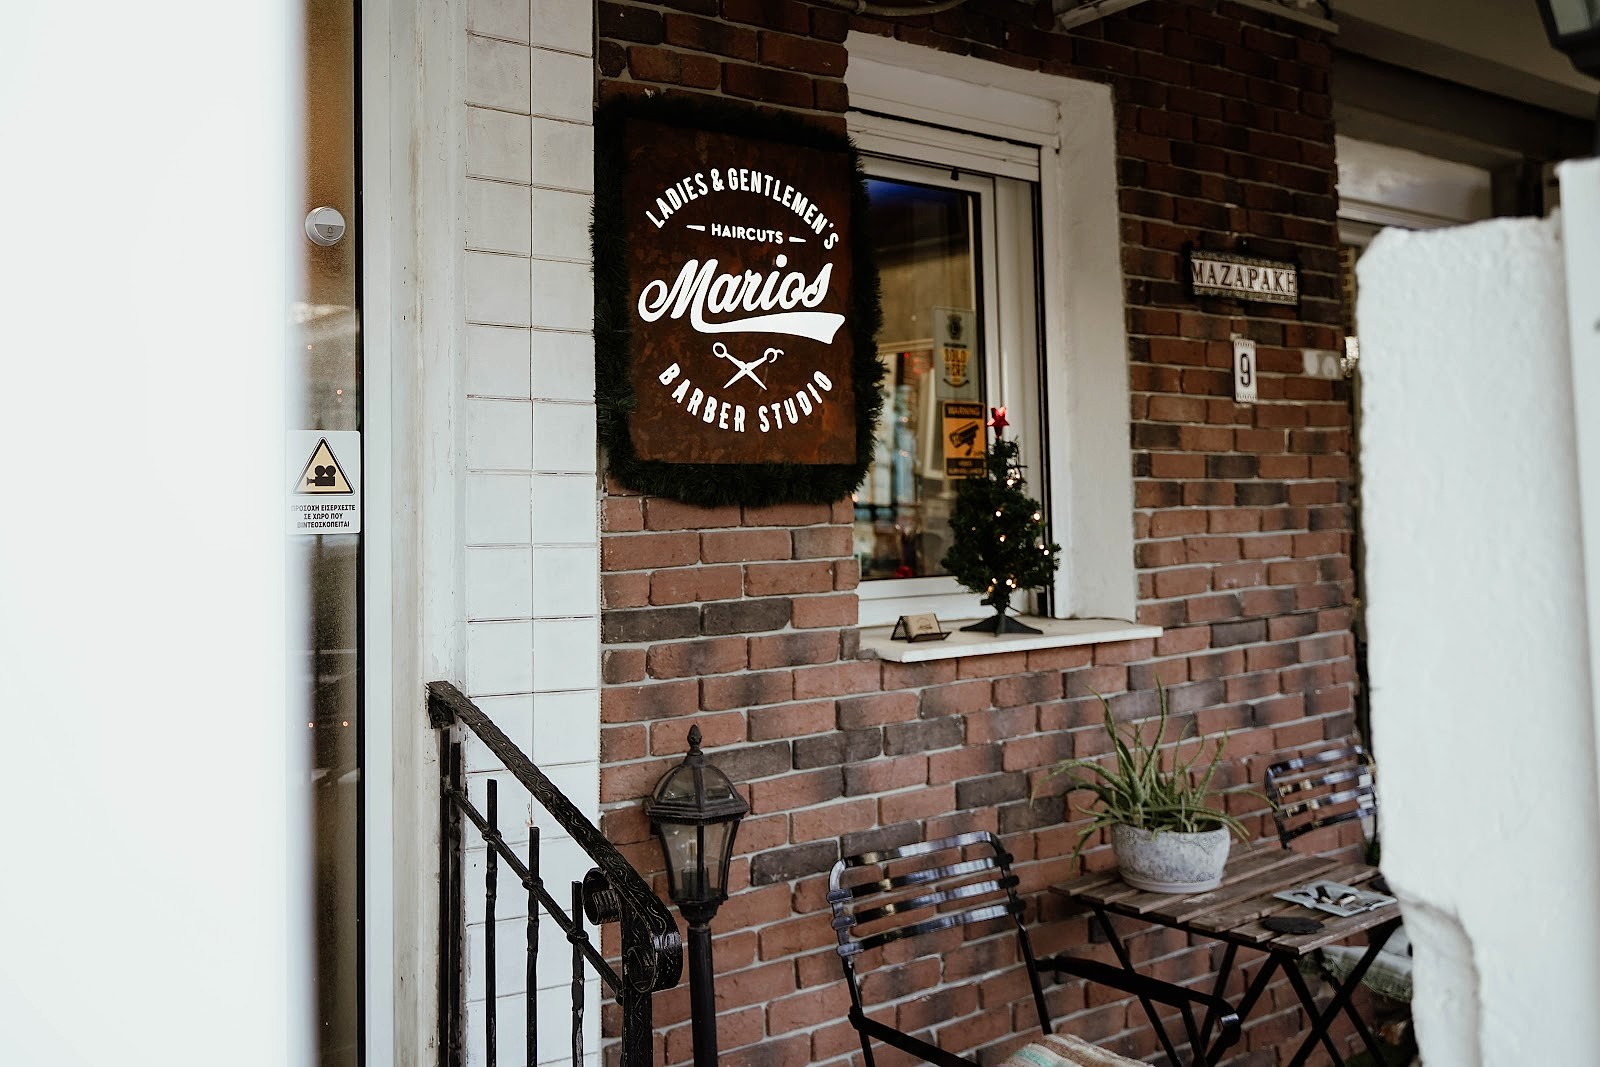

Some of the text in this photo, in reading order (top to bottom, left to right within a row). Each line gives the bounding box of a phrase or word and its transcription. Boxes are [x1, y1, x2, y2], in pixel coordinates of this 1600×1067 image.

[646, 168, 839, 249] LADIES & GENTLEMEN'S
[711, 223, 784, 244] HAIRCUTS
[638, 254, 845, 344] Marios
[658, 363, 833, 432] BARBER STUDIO
[1240, 353, 1251, 387] 9
